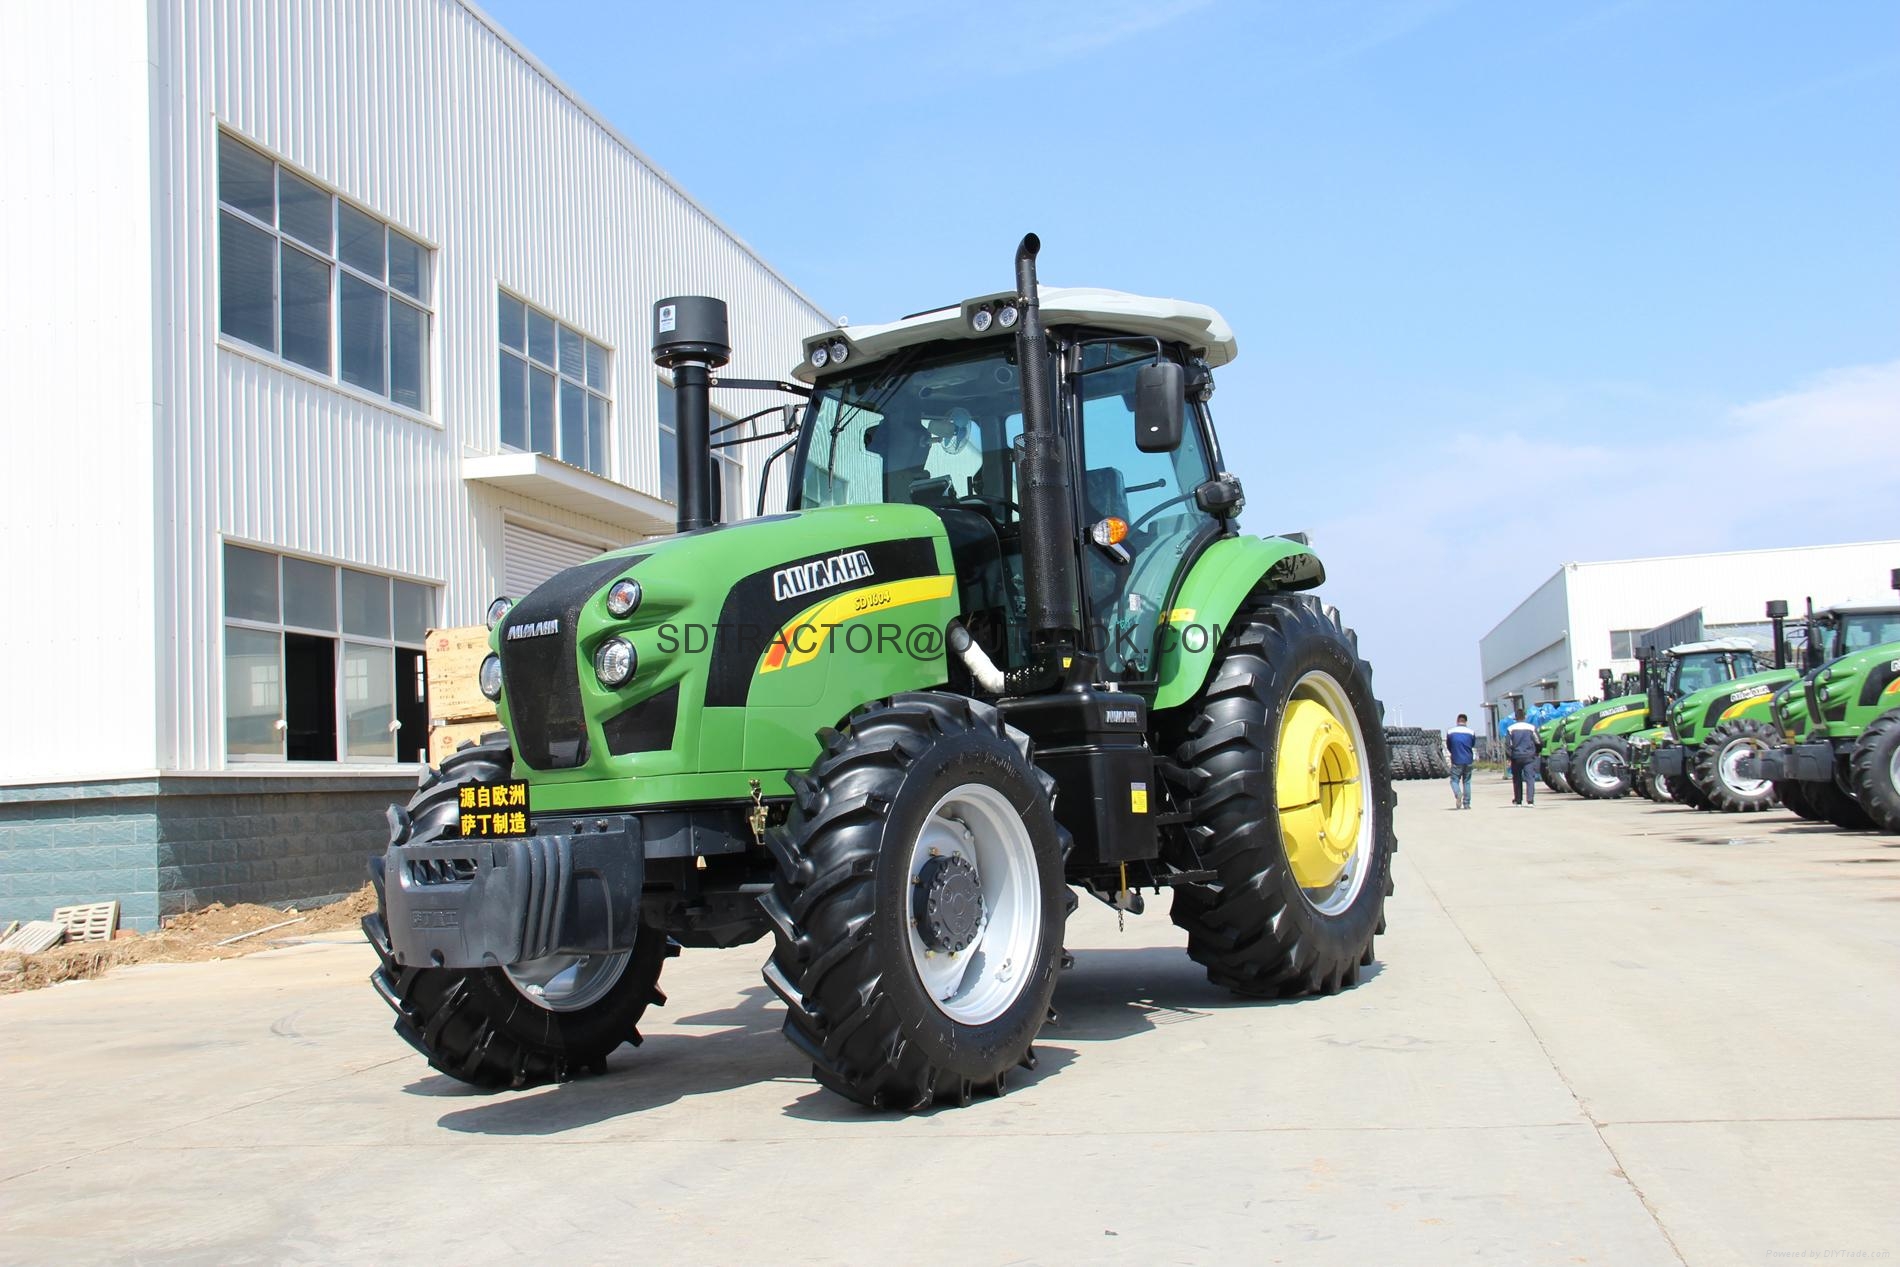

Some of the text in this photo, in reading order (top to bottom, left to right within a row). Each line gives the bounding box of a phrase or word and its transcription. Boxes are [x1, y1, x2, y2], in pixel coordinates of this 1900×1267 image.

[460, 784, 526, 809] 源自欧洲
[460, 811, 527, 836] 萨丁制造
